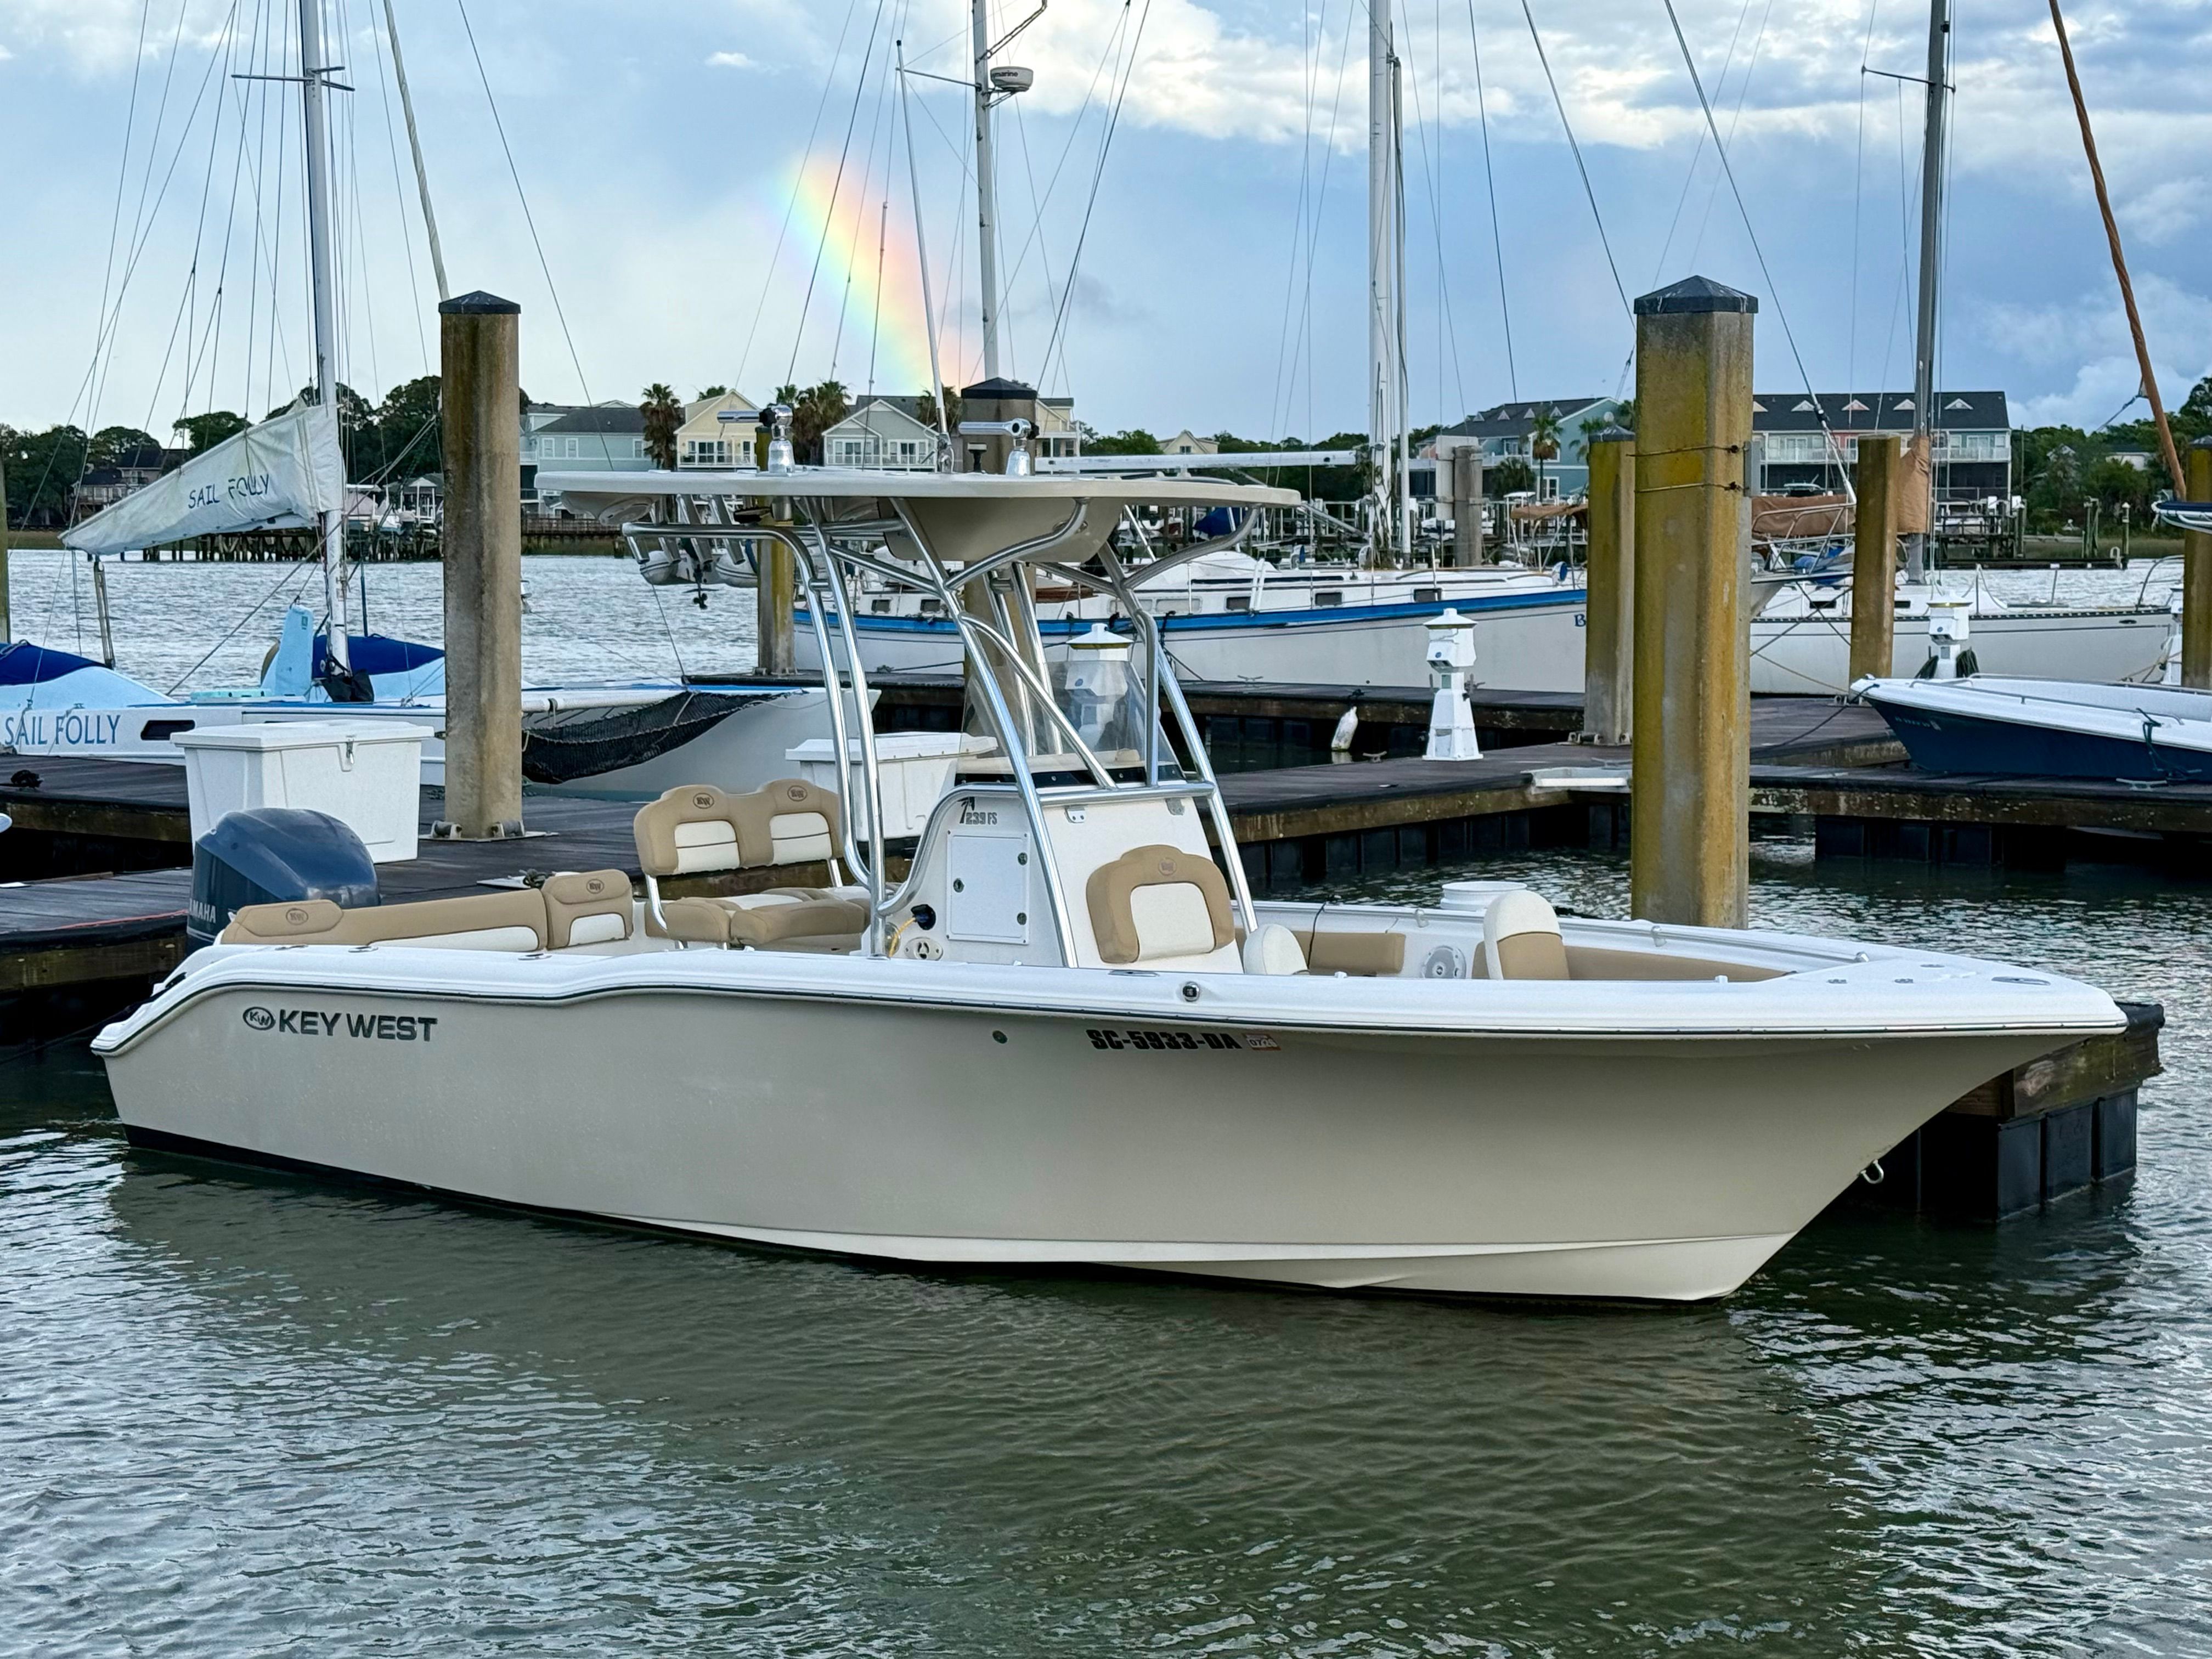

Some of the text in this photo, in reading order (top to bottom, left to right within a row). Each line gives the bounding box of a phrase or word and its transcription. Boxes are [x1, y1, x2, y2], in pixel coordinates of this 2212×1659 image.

[188, 473, 269, 509] SAIL FOLLY
[1574, 614, 1587, 627] B
[5, 715, 121, 745] SAIL FOLLY
[988, 812, 997, 825] FS
[189, 898, 216, 923] AMAHA
[279, 1009, 342, 1036] KEY
[346, 1013, 438, 1041] WEST
[1086, 1029, 1243, 1049] SC-5933-DA
